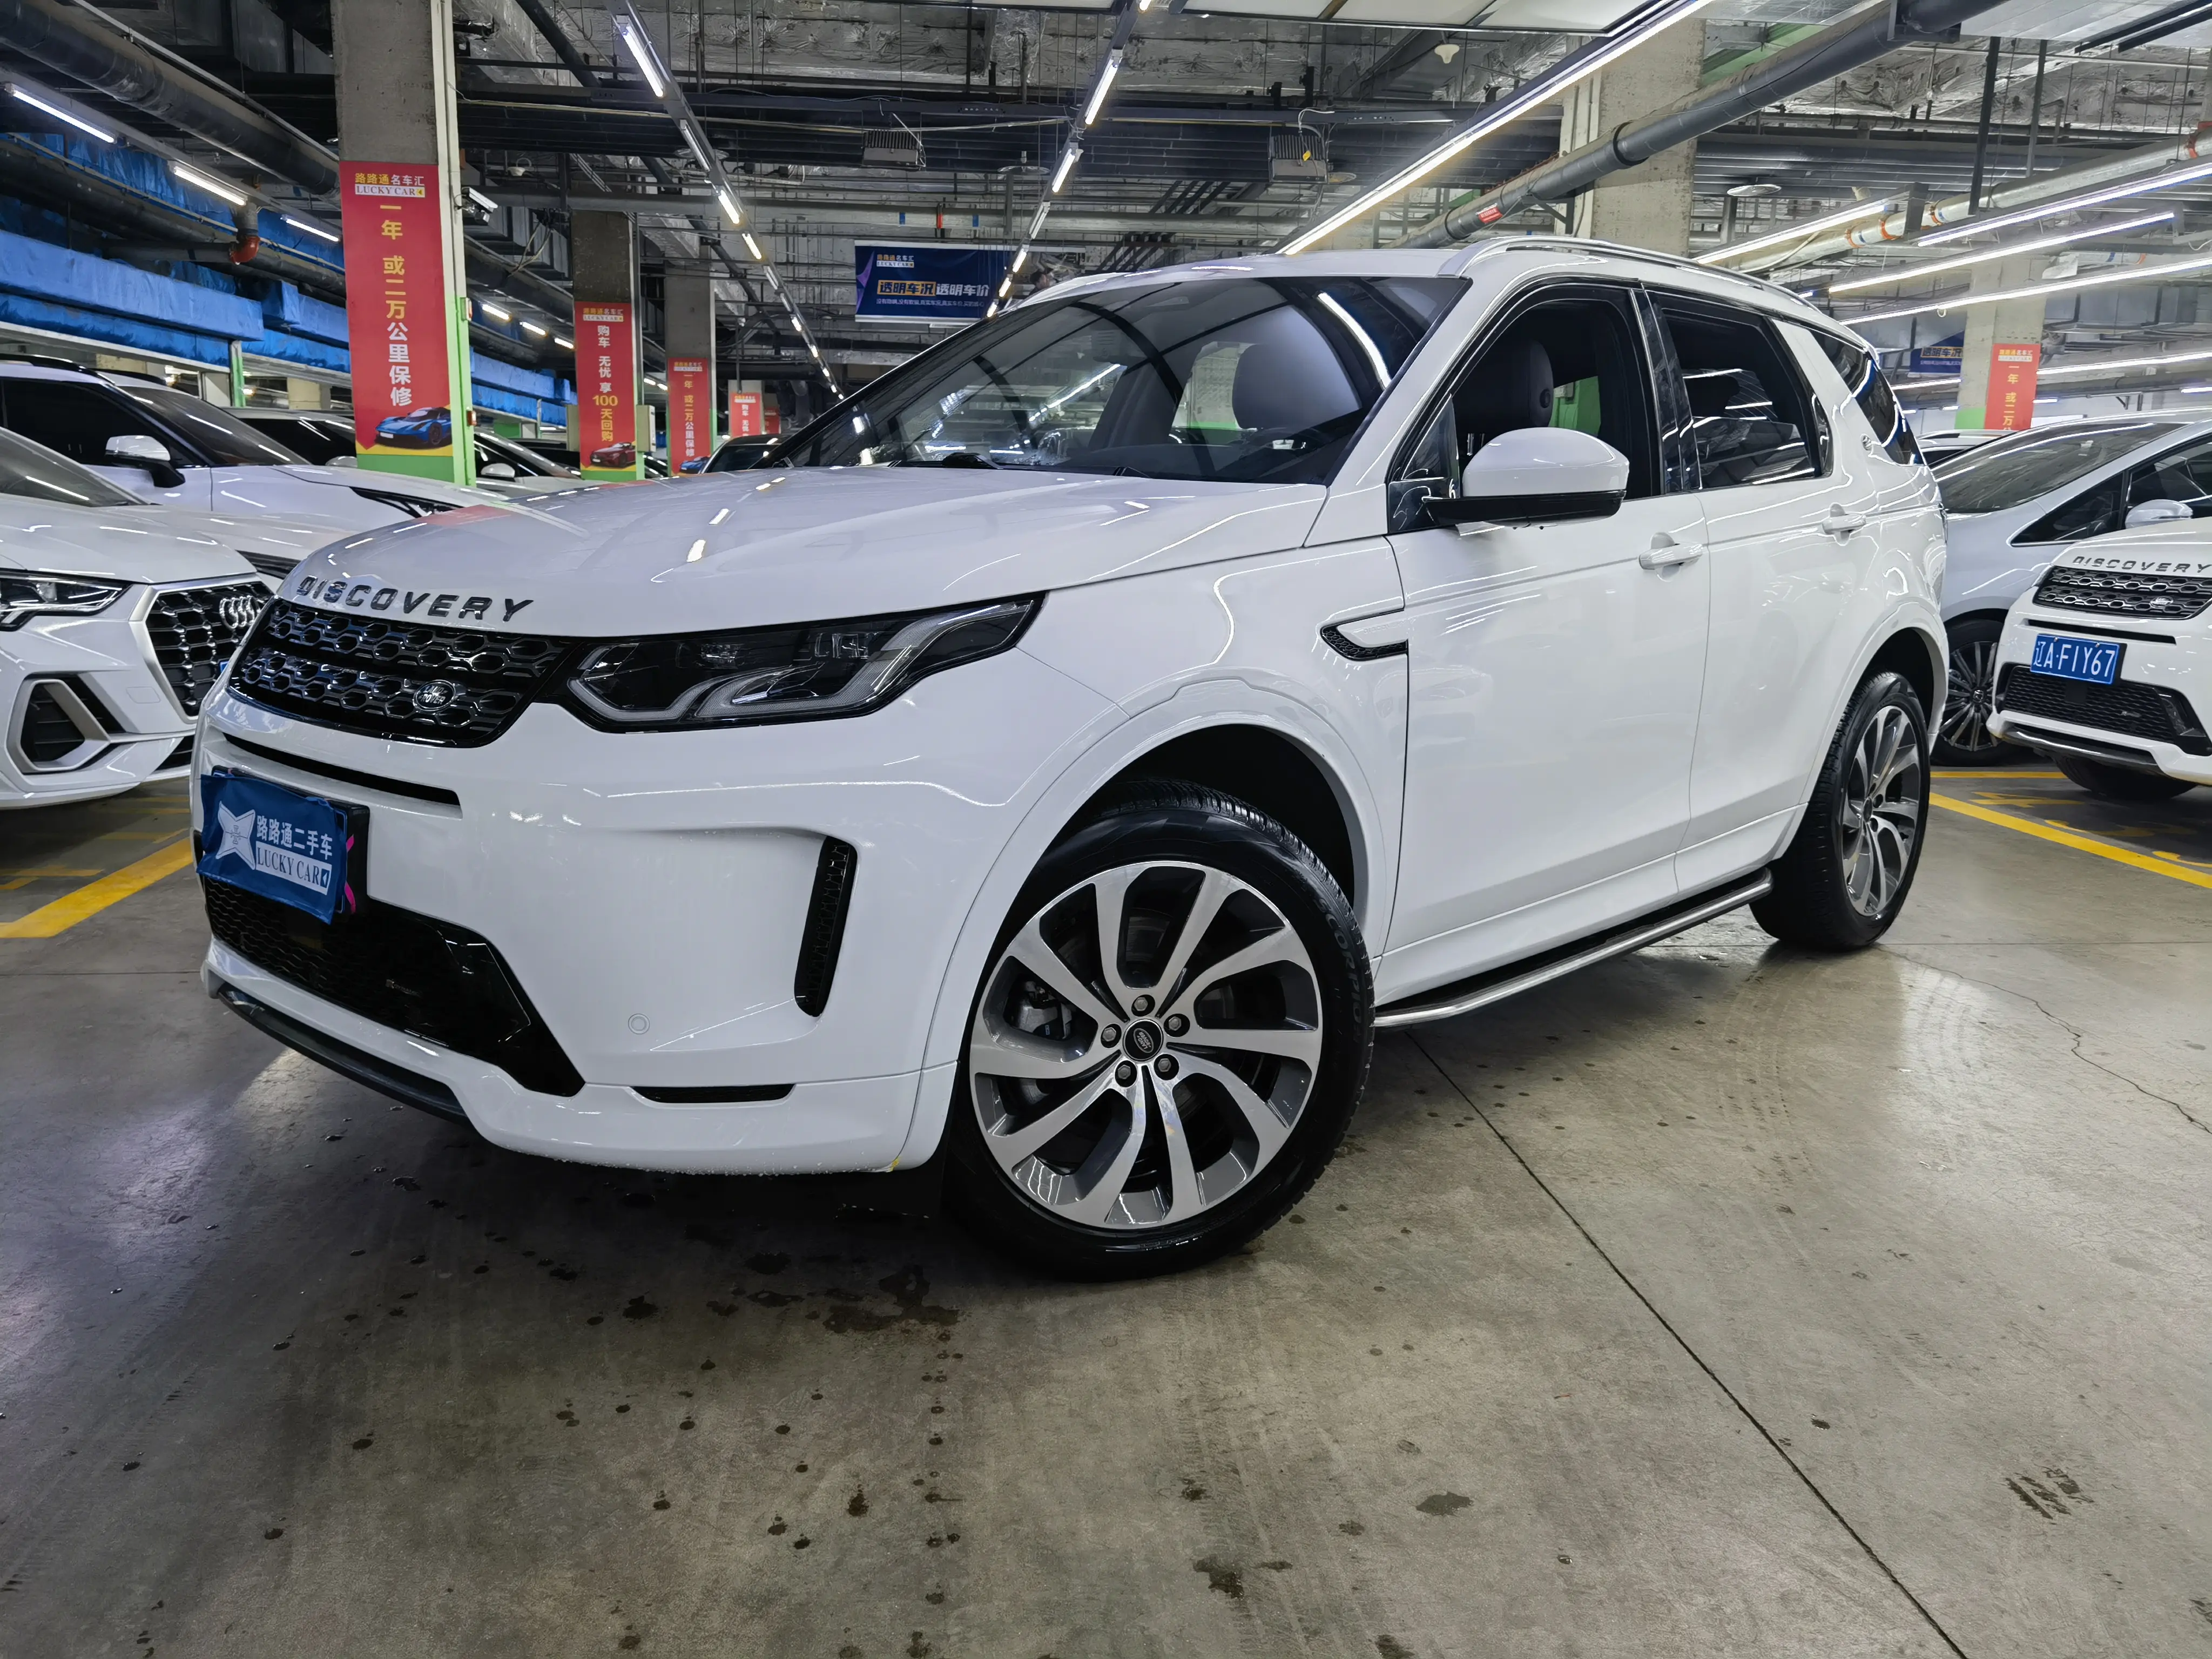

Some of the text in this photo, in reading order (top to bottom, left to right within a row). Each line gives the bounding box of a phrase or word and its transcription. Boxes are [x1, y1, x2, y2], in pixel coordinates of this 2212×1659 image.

[355, 173, 425, 186] 路路通名车汇
[356, 185, 416, 196] LUCKY CAR
[879, 281, 990, 296] 透明车况 透明车价
[380, 205, 413, 406] 一年 或二万公里保修
[597, 325, 610, 348] 购车
[598, 355, 611, 378] 无忧
[2072, 555, 2212, 574] DISCOVERY
[296, 575, 534, 622] DISCOVERY
[420, 693, 446, 705] ROVER
[257, 815, 333, 860] 路路通二手车
[257, 846, 320, 886] LUCKY CAR
